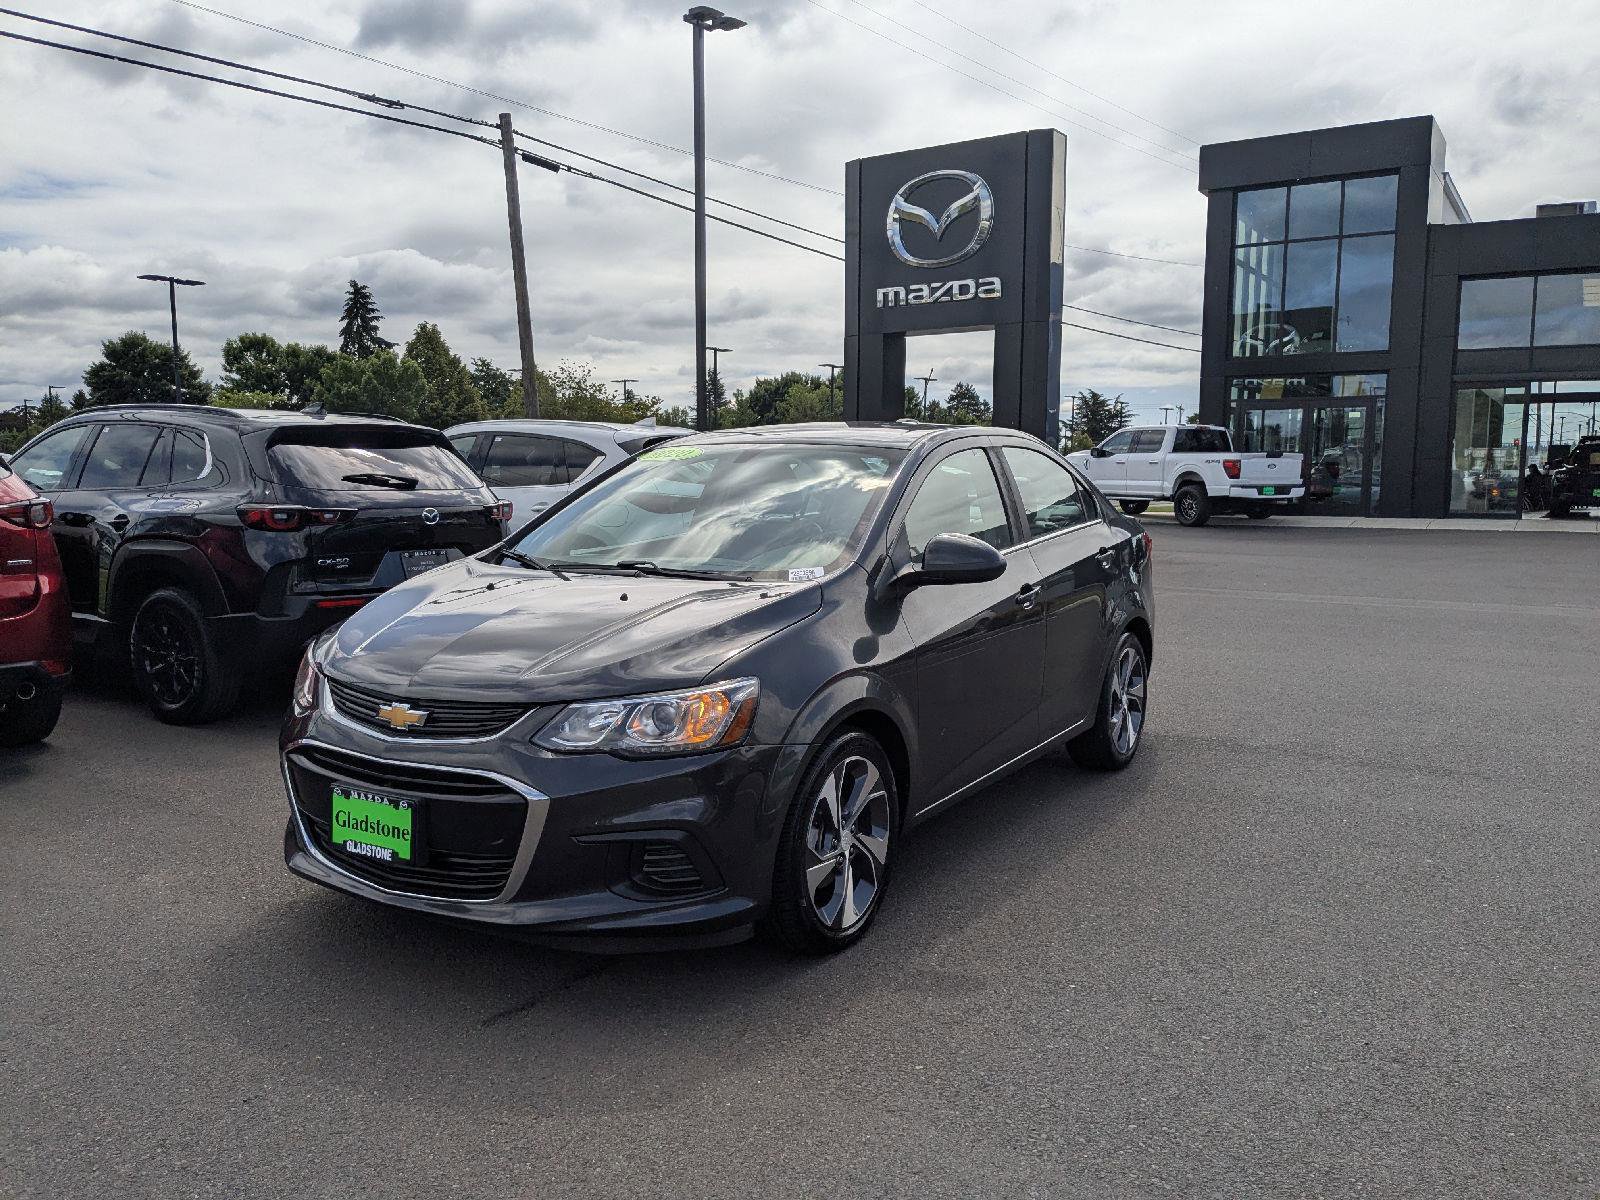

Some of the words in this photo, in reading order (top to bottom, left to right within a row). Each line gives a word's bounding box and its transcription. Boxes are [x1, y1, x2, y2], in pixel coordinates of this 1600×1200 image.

[876, 276, 1002, 308] mazda
[350, 790, 390, 806] MAZDA
[335, 809, 410, 841] Gladstone
[346, 840, 393, 861] GLADSTONE
